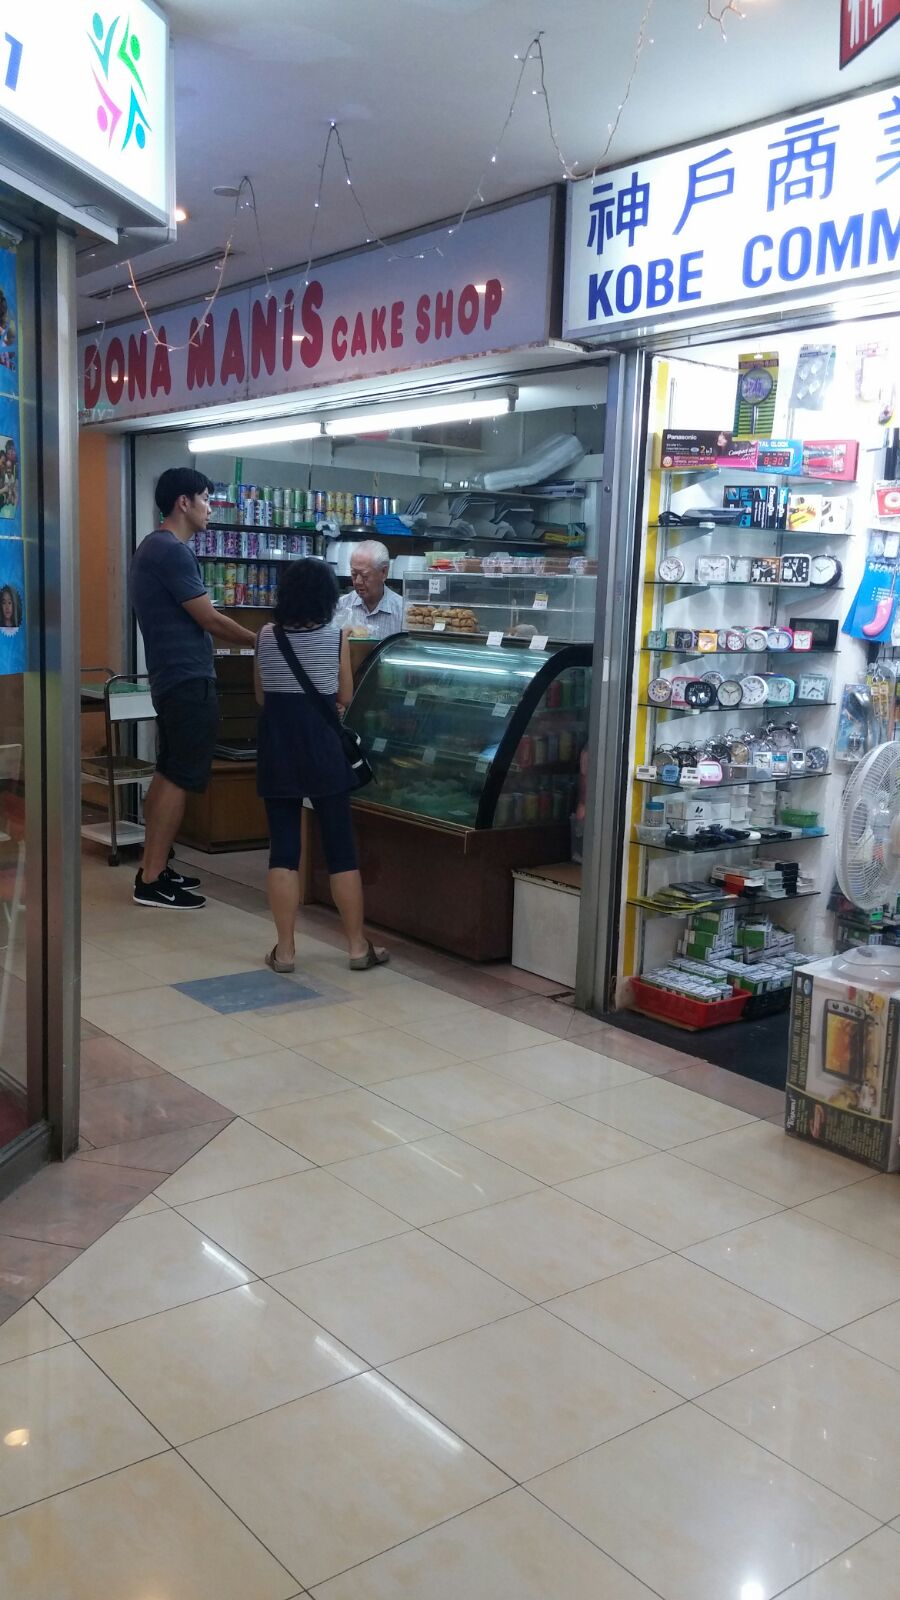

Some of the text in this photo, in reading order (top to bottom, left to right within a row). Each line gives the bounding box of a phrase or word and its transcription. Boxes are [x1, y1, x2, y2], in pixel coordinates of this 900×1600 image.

[587, 249, 704, 321] KOBE
[83, 325, 172, 410] DONA
[331, 300, 405, 362] CAKE
[415, 278, 503, 345] SHOP
[666, 433, 698, 441] Panasonic
